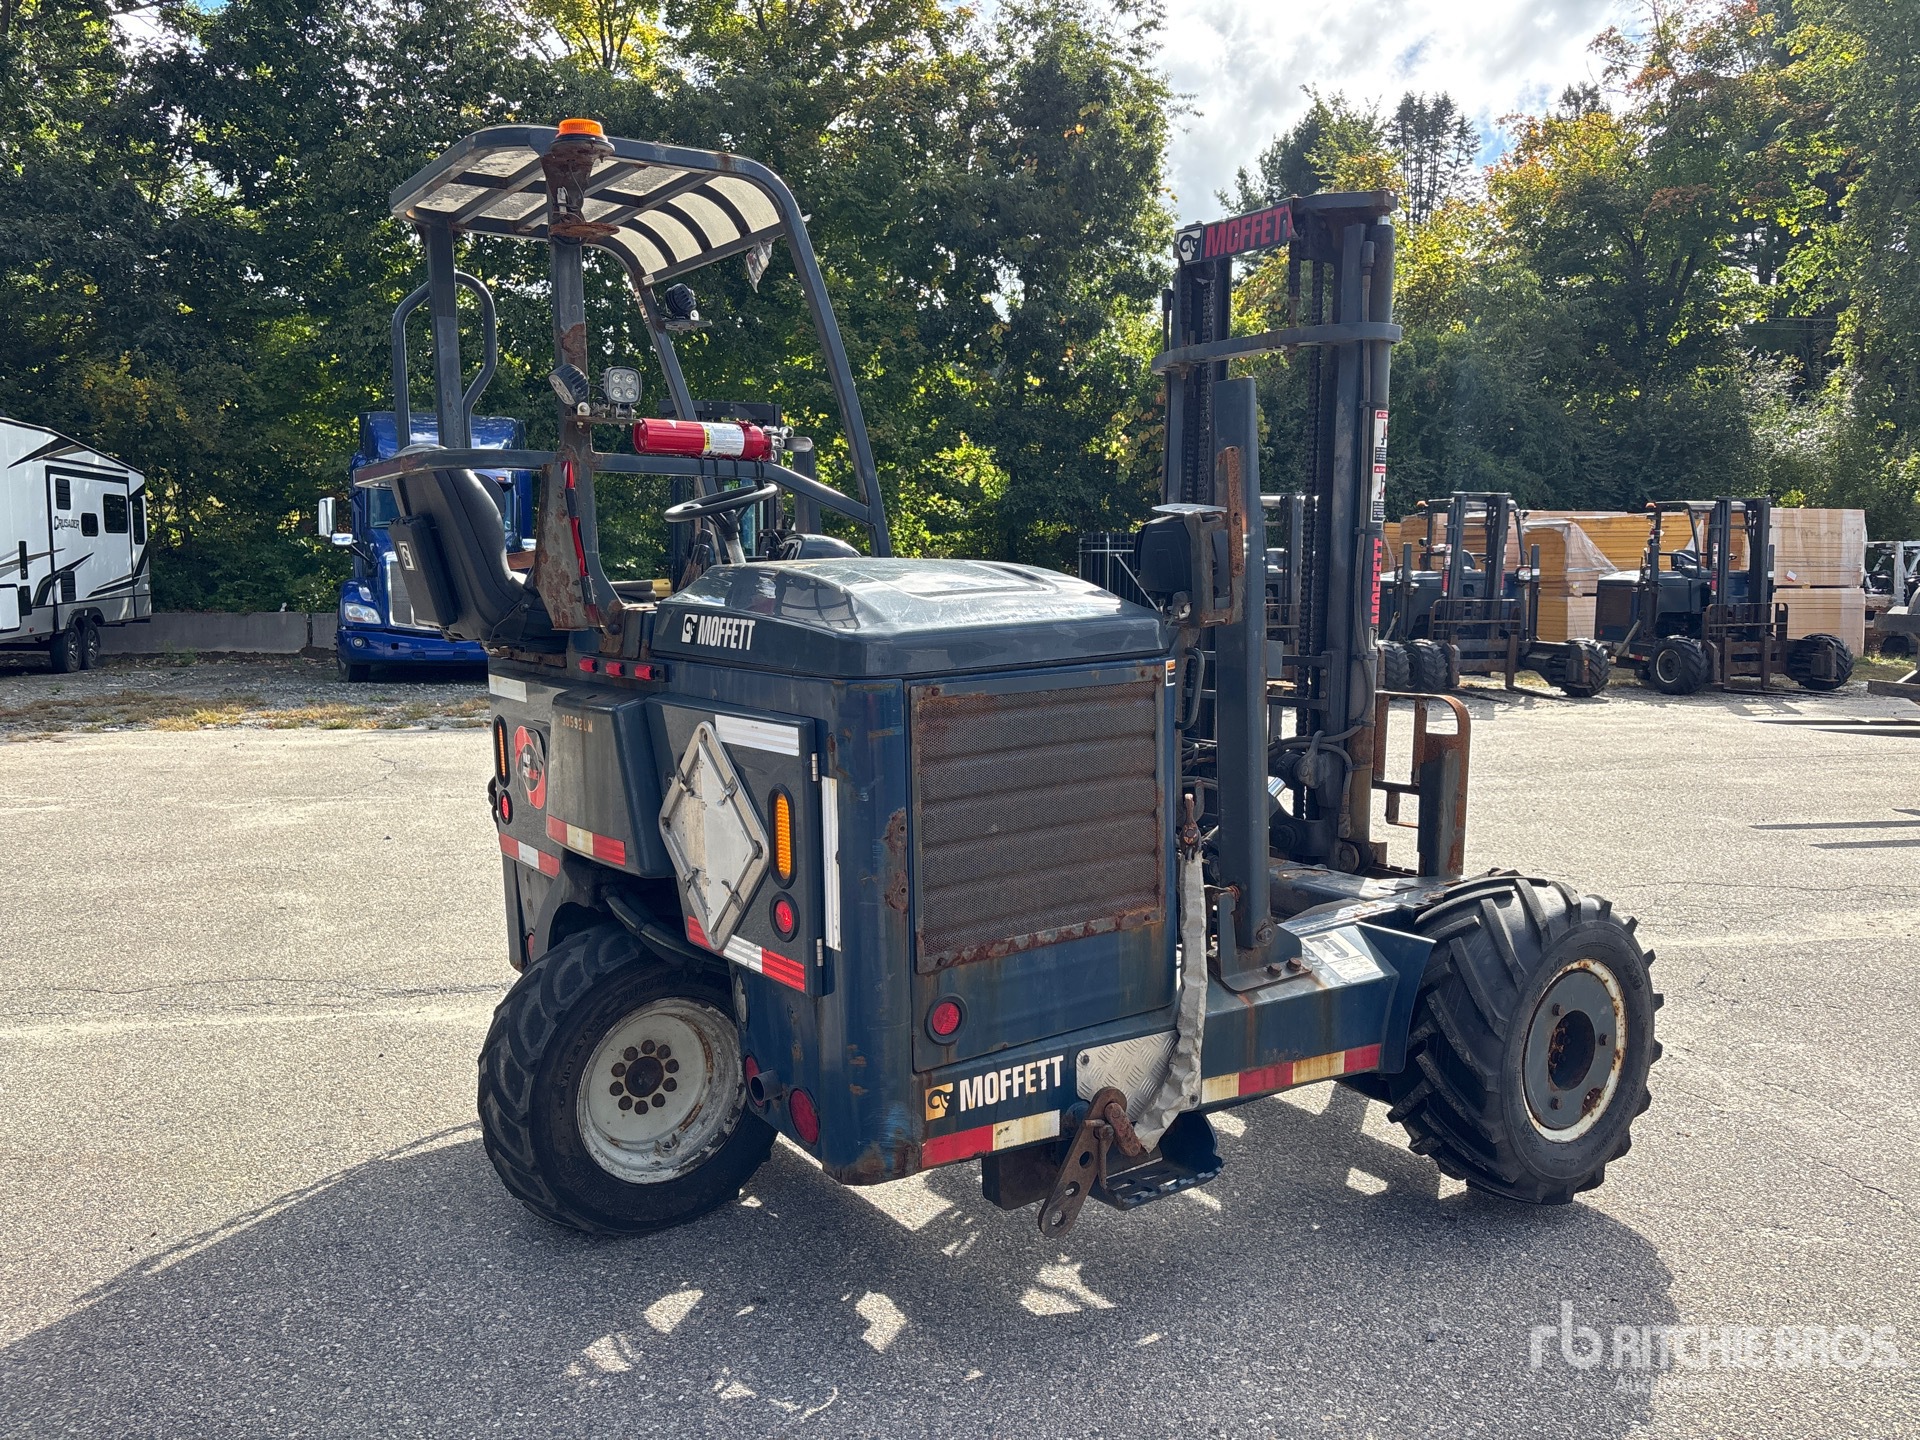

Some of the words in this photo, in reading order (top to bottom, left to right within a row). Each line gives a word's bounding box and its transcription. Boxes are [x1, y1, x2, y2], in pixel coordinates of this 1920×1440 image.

[1204, 203, 1293, 258] MOFFETT
[697, 615, 756, 651] MOFFETT
[959, 1054, 1064, 1112] MOFFETT
